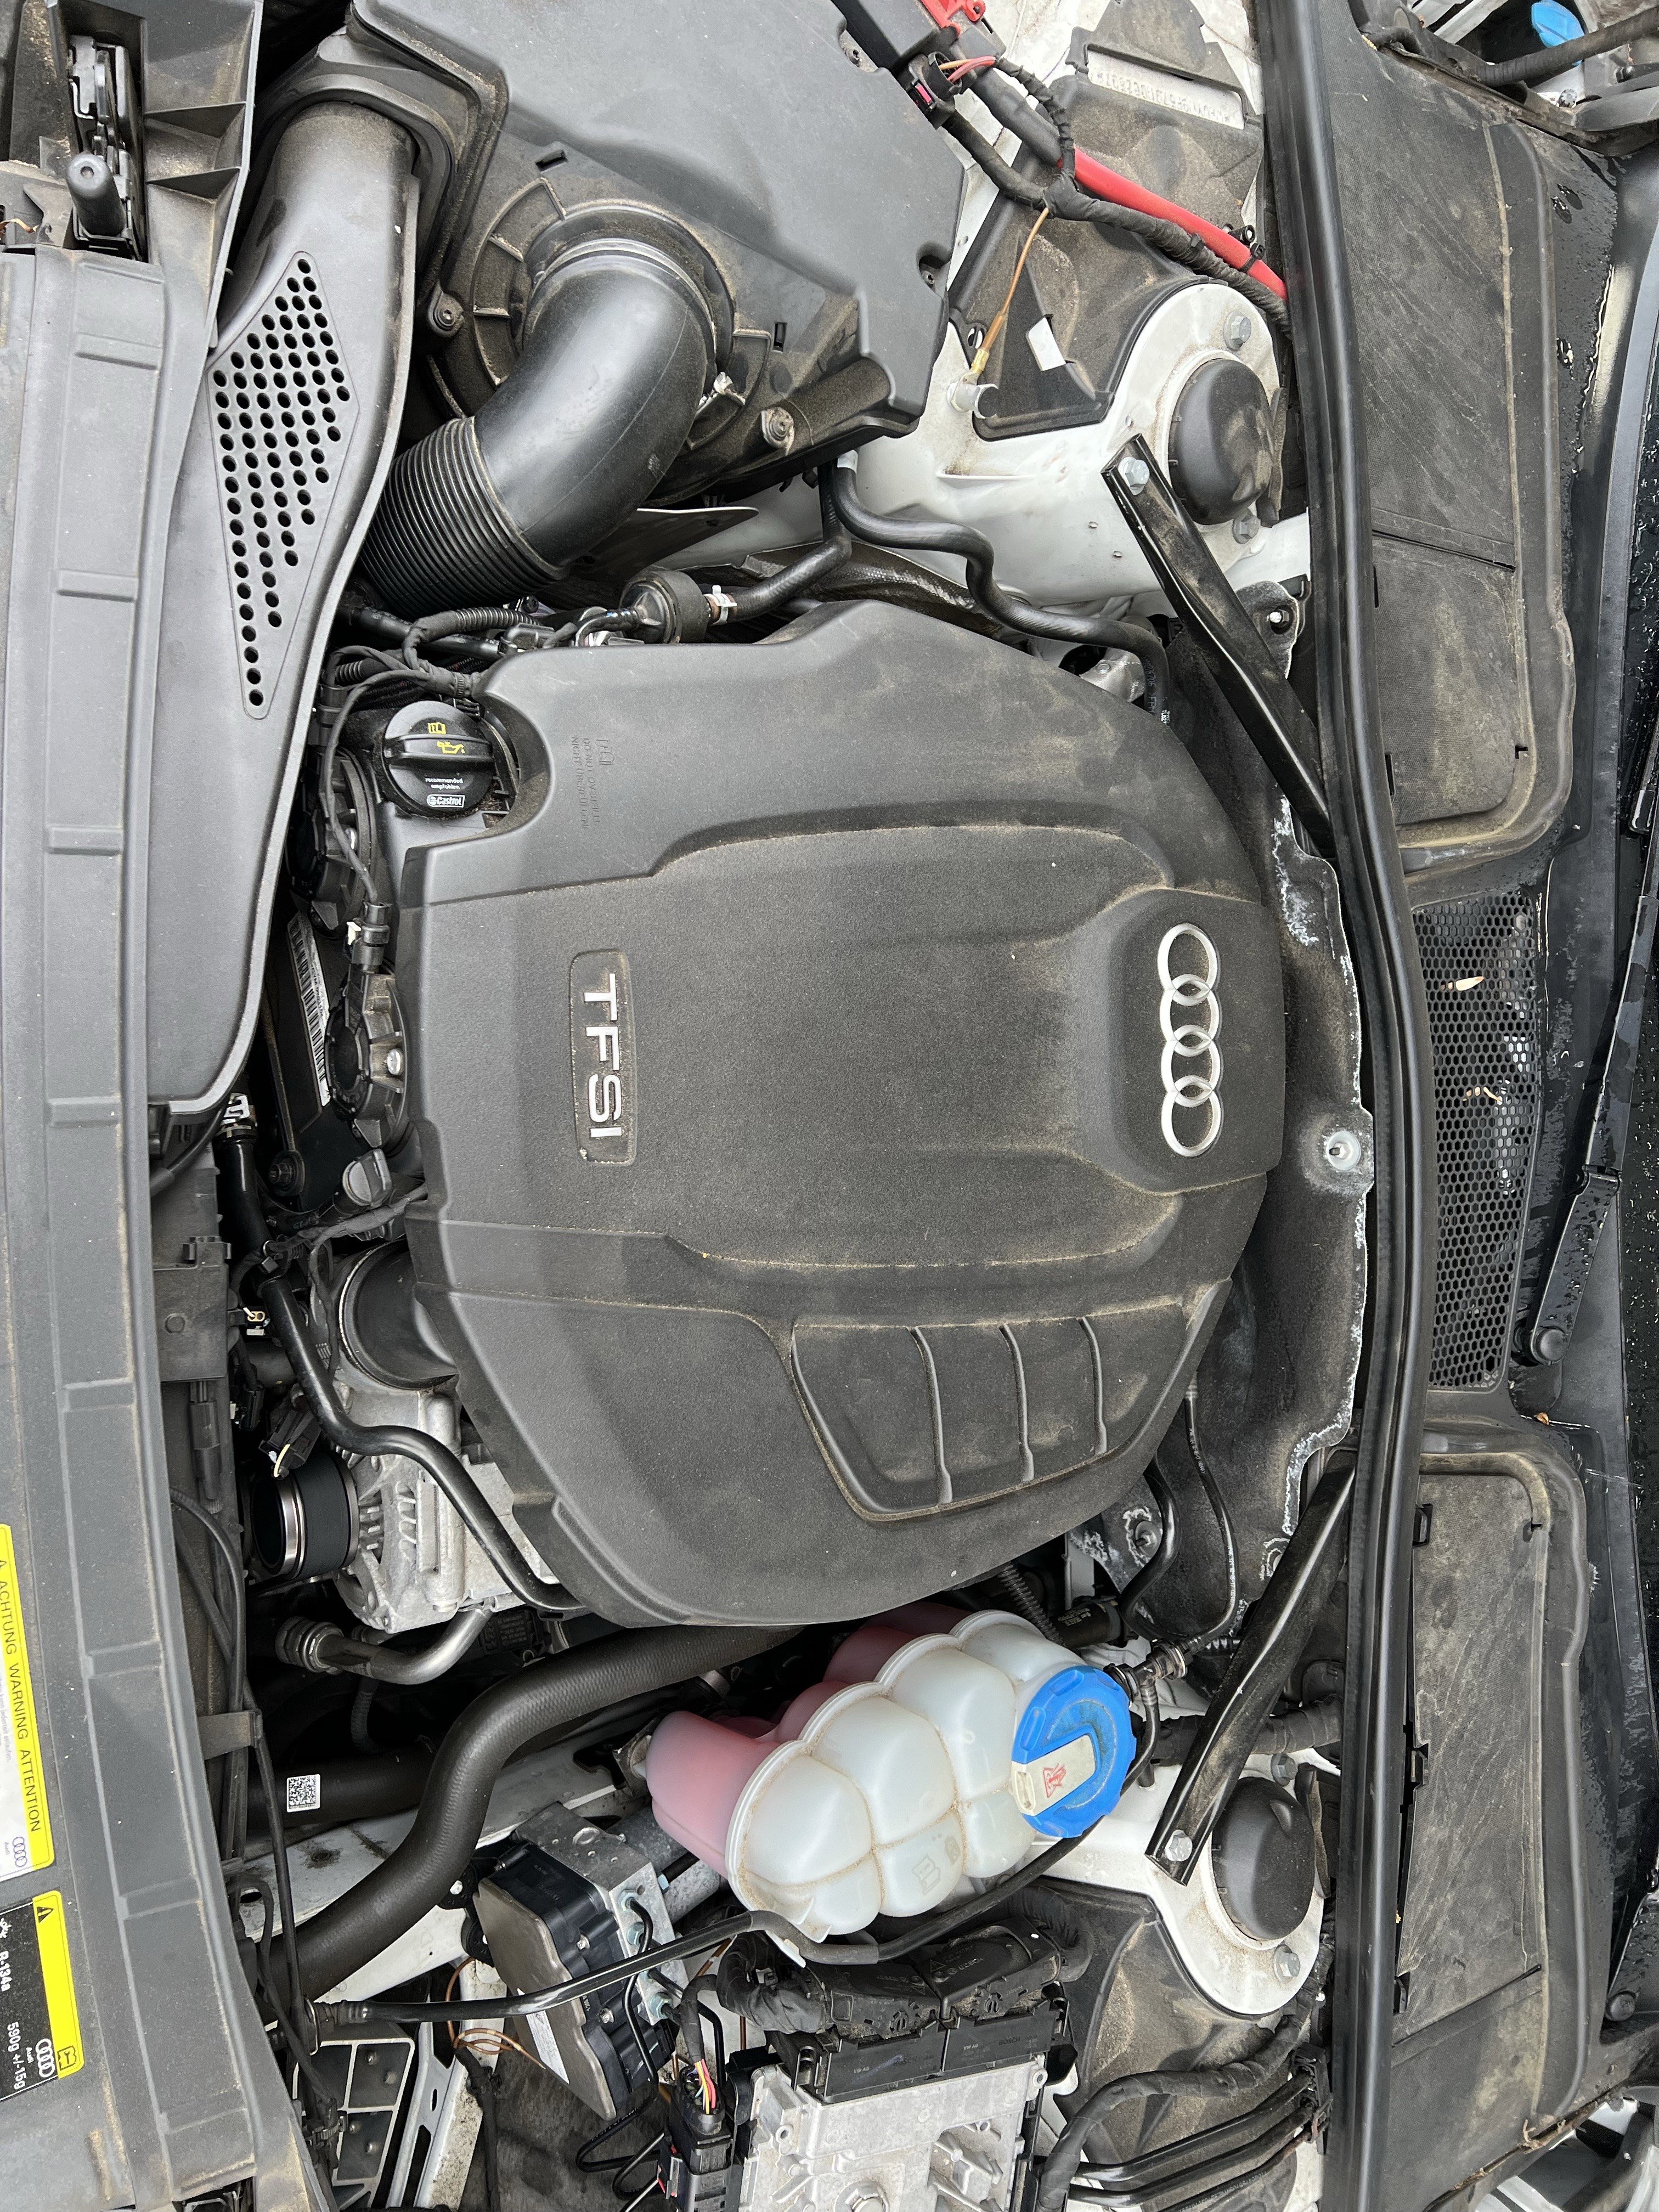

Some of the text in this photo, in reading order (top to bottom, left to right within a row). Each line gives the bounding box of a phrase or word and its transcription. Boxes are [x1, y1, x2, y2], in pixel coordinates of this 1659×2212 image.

[437, 796, 462, 805] Castrol
[584, 973, 622, 1138] TFSI
[0, 1581, 42, 1832] ACHTUNG WARNING ATTENTION
[0, 1950, 27, 2090] R-134a 590g +/-15g
